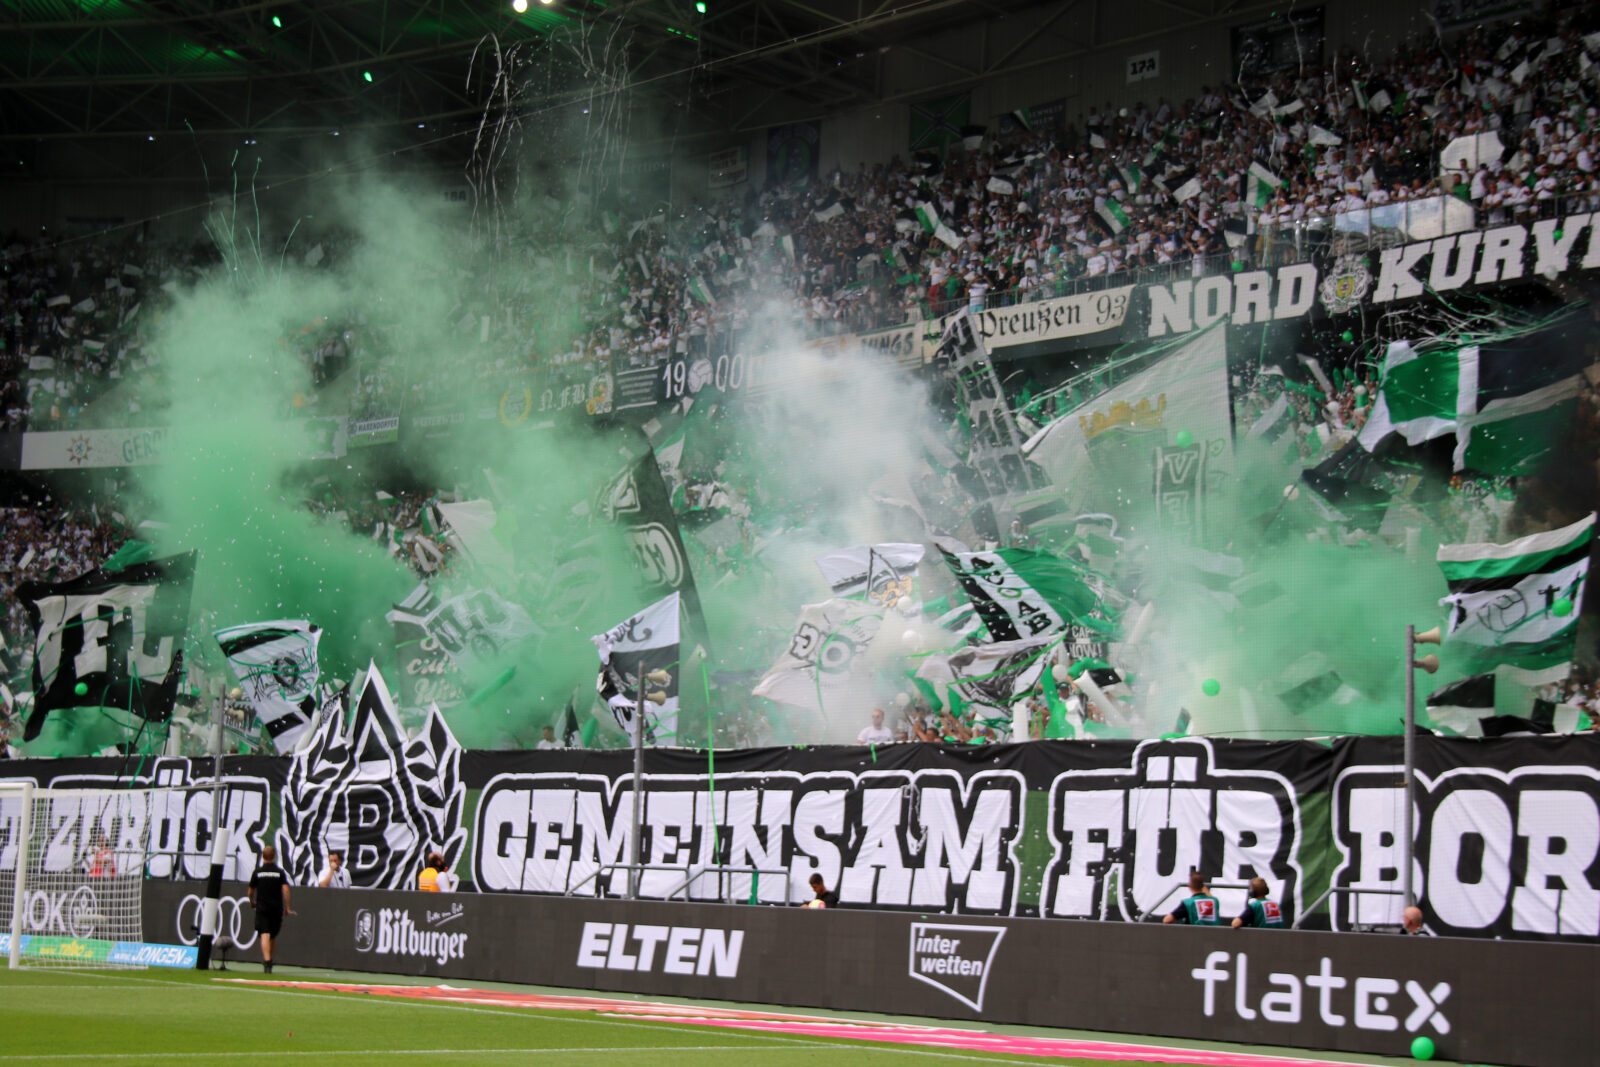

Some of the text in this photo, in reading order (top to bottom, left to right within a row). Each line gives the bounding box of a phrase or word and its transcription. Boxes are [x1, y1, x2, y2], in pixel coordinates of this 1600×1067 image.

[1130, 56, 1157, 76] 17A
[979, 301, 1081, 343] Preußen
[1147, 263, 1318, 338] NORD
[662, 361, 687, 399] 19
[480, 756, 1600, 936] GEMEINSAM FÜR BOR
[375, 907, 468, 966] Bitburger
[577, 922, 744, 978] ELTEN
[916, 933, 959, 955] inter
[920, 956, 983, 977] wetten
[1191, 951, 1451, 1034] flatex
